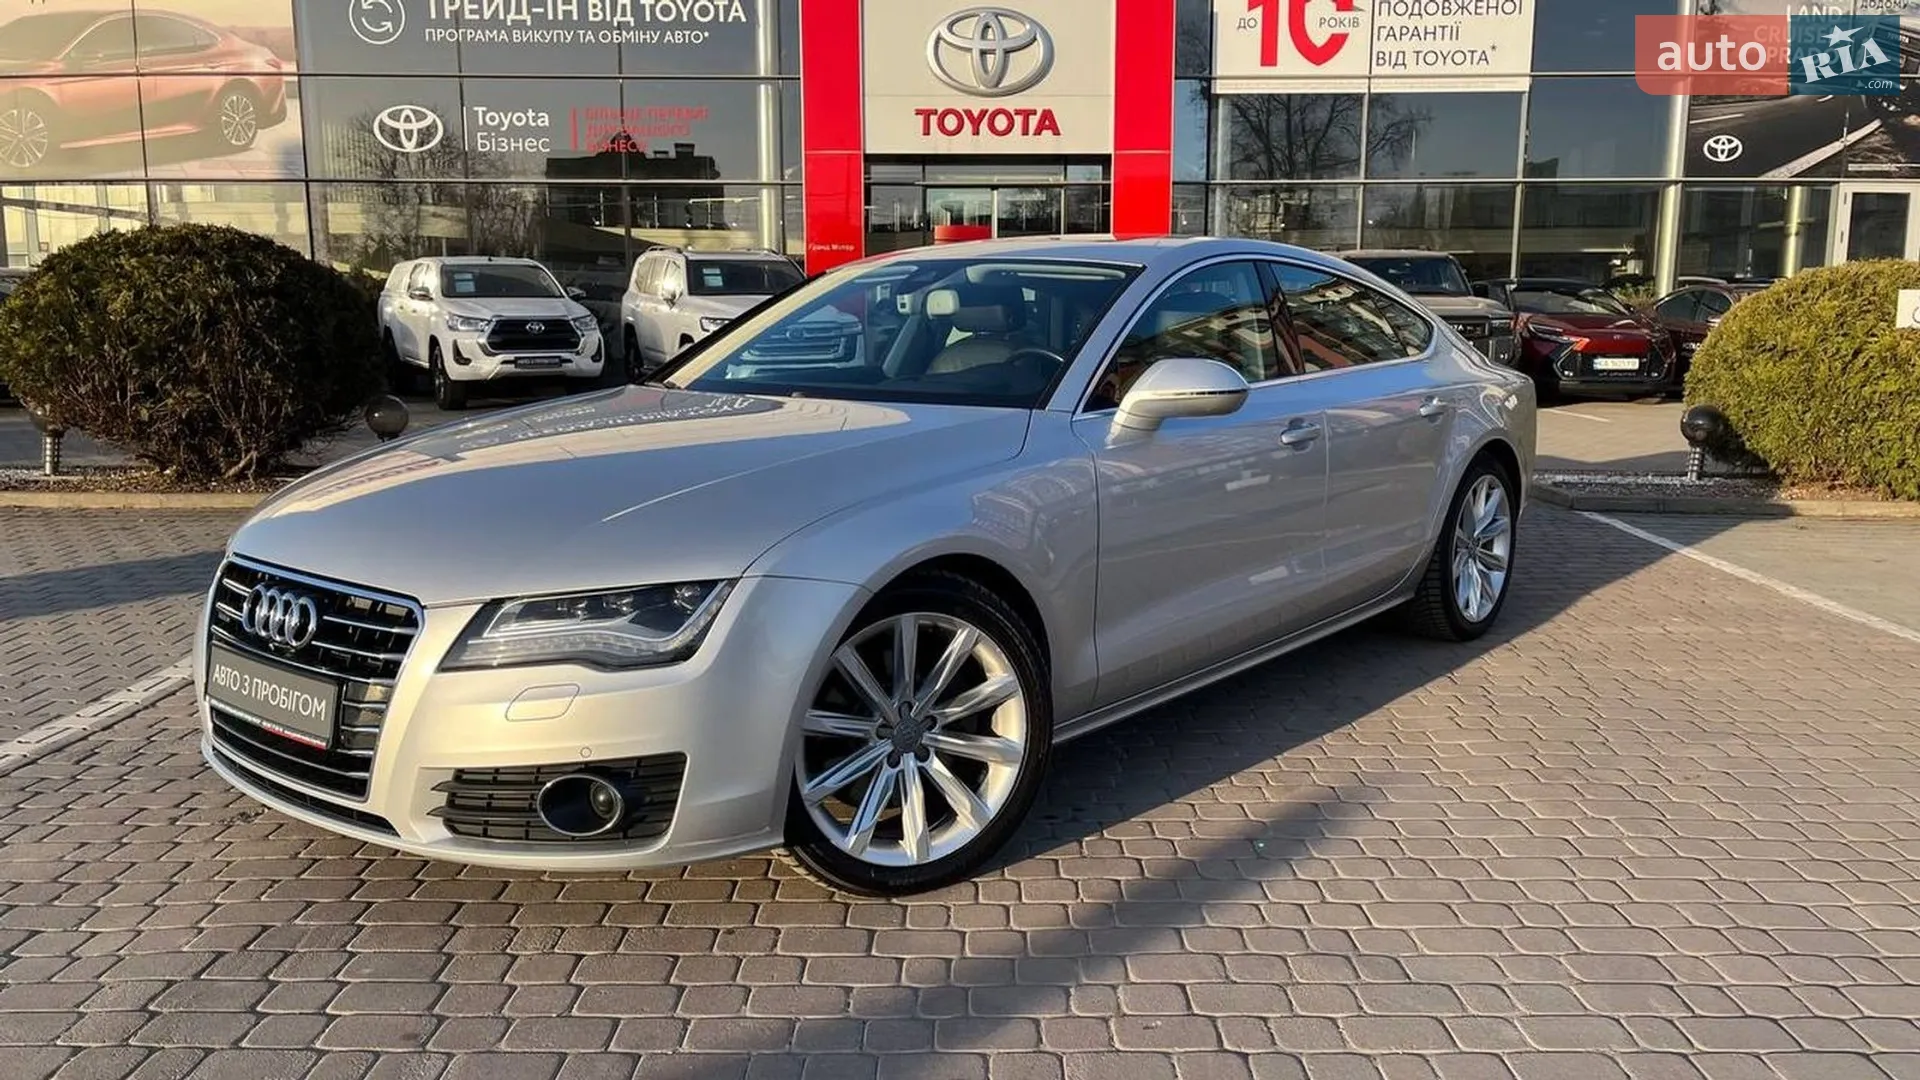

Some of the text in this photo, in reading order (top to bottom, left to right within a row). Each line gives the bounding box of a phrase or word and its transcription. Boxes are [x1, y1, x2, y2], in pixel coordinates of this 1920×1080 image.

[588, 0, 635, 27] ВІД
[639, 0, 747, 23] TOYOTA
[1237, 17, 1258, 31] ДО
[1318, 16, 1360, 29] РОКІВ
[1786, 4, 1843, 23] LAND
[425, 28, 509, 43] ПРОГРАМА
[512, 29, 574, 43] ВИКУПУ
[578, 30, 596, 43] ТА
[599, 30, 661, 44] ОБМІНУ
[1376, 21, 1461, 42] ГАРАНТІЇ
[1753, 24, 1841, 44] CRUISE
[1375, 50, 1407, 69] ВІД
[473, 106, 549, 130] Toyota
[914, 107, 1061, 138] TOYOTA
[476, 132, 550, 152] Бізнес
[212, 663, 326, 721] АВТО З ПРОБІГОМ
